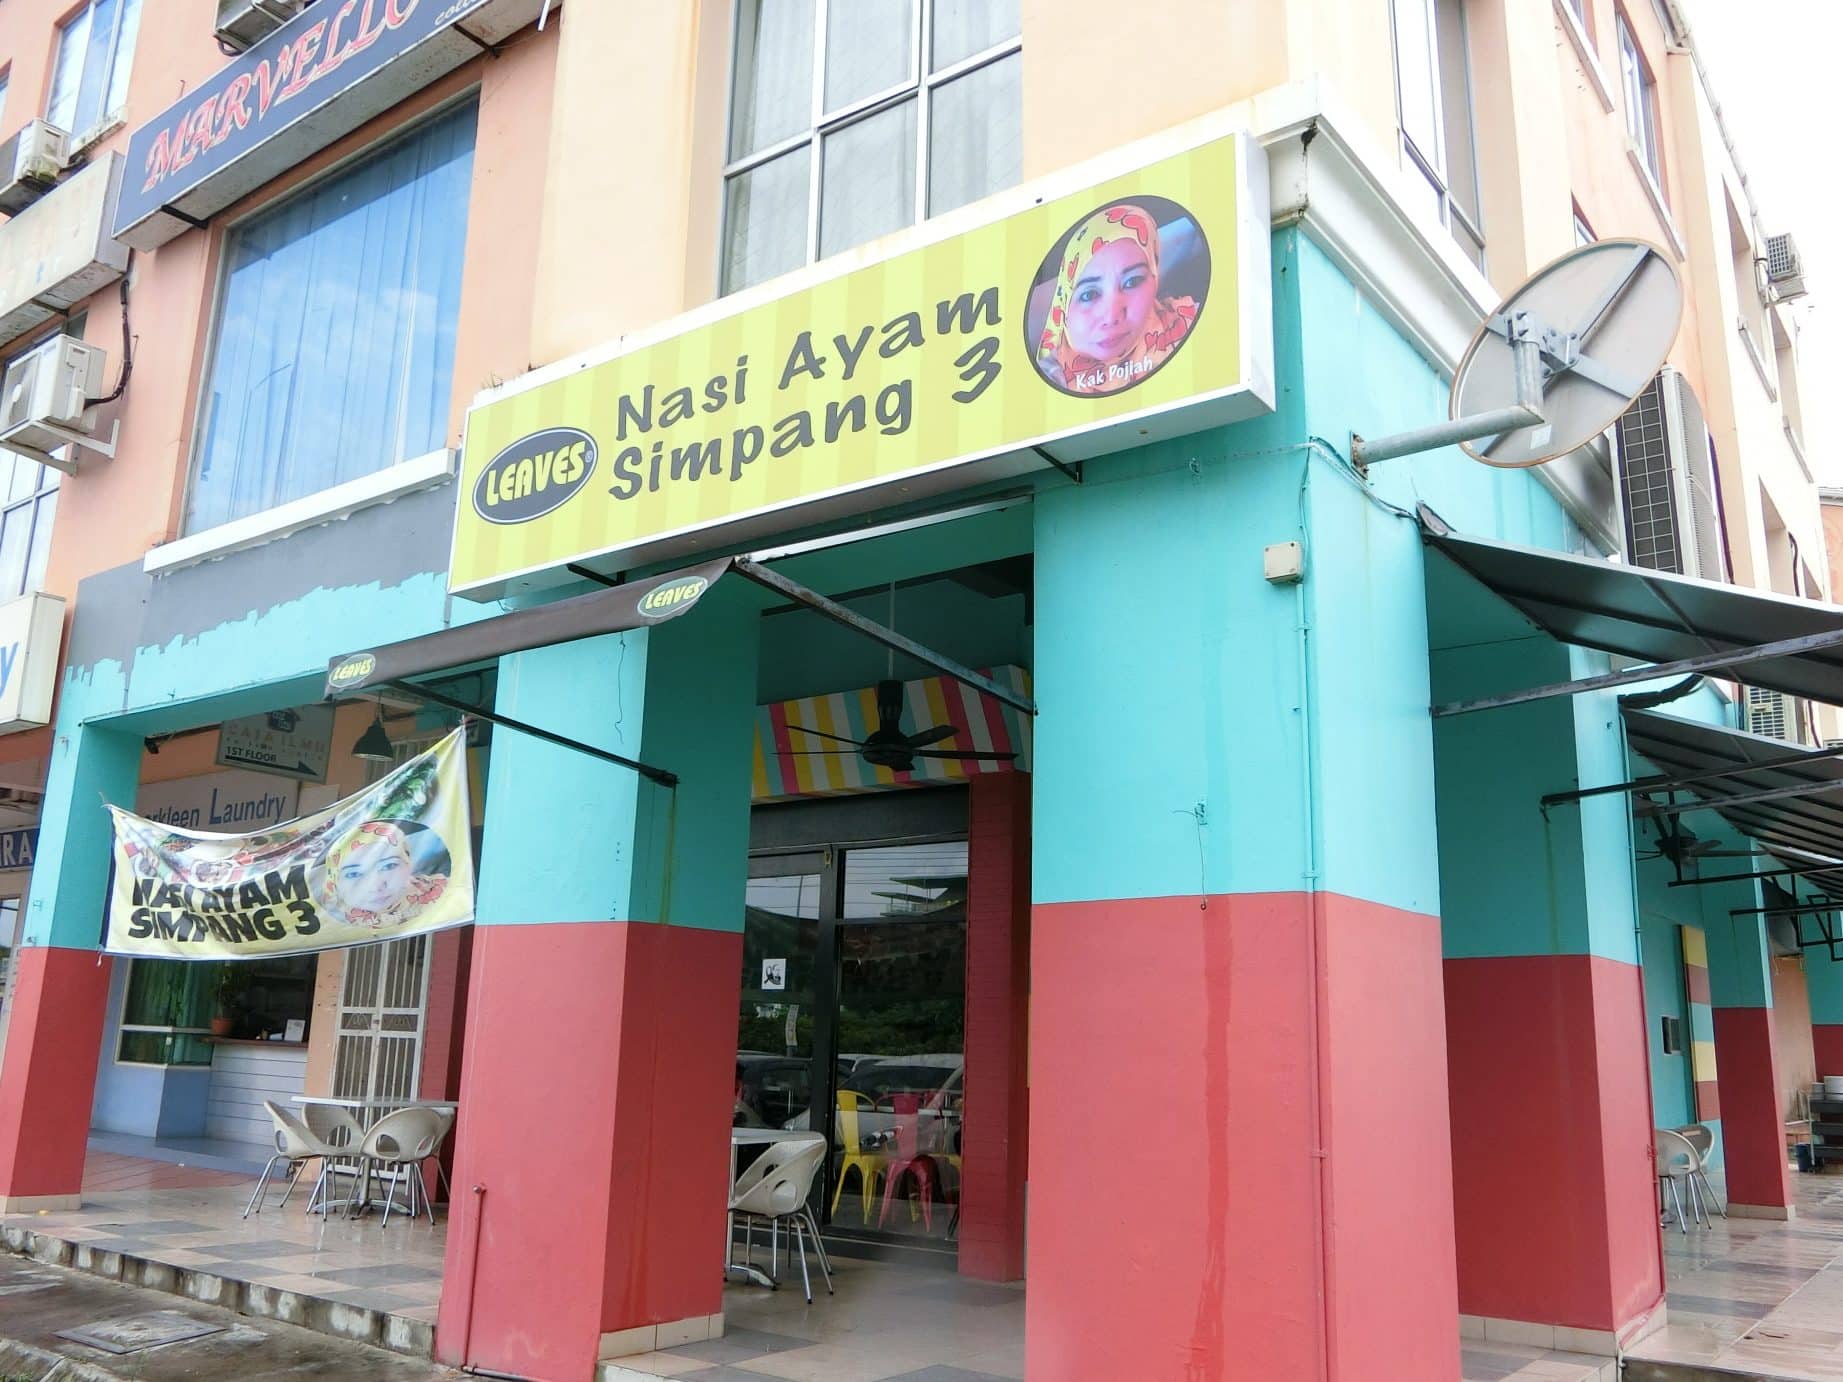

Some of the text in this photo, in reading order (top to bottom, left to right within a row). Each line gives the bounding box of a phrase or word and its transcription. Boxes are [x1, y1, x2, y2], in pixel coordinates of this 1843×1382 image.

[616, 286, 1002, 441] Nasi Ayam
[1075, 369, 1105, 389] Kak
[608, 336, 1002, 500] Simpang 3
[486, 440, 586, 506] LEAVES
[645, 581, 704, 610] LEAVES
[332, 658, 373, 681] LEAVES
[226, 745, 243, 757] 1ST
[244, 748, 278, 762] FLOOR
[144, 788, 287, 828] rkleen Laundry
[200, 864, 310, 914] AYAM
[128, 907, 288, 944] SIMPANG
[287, 900, 322, 936] 3
